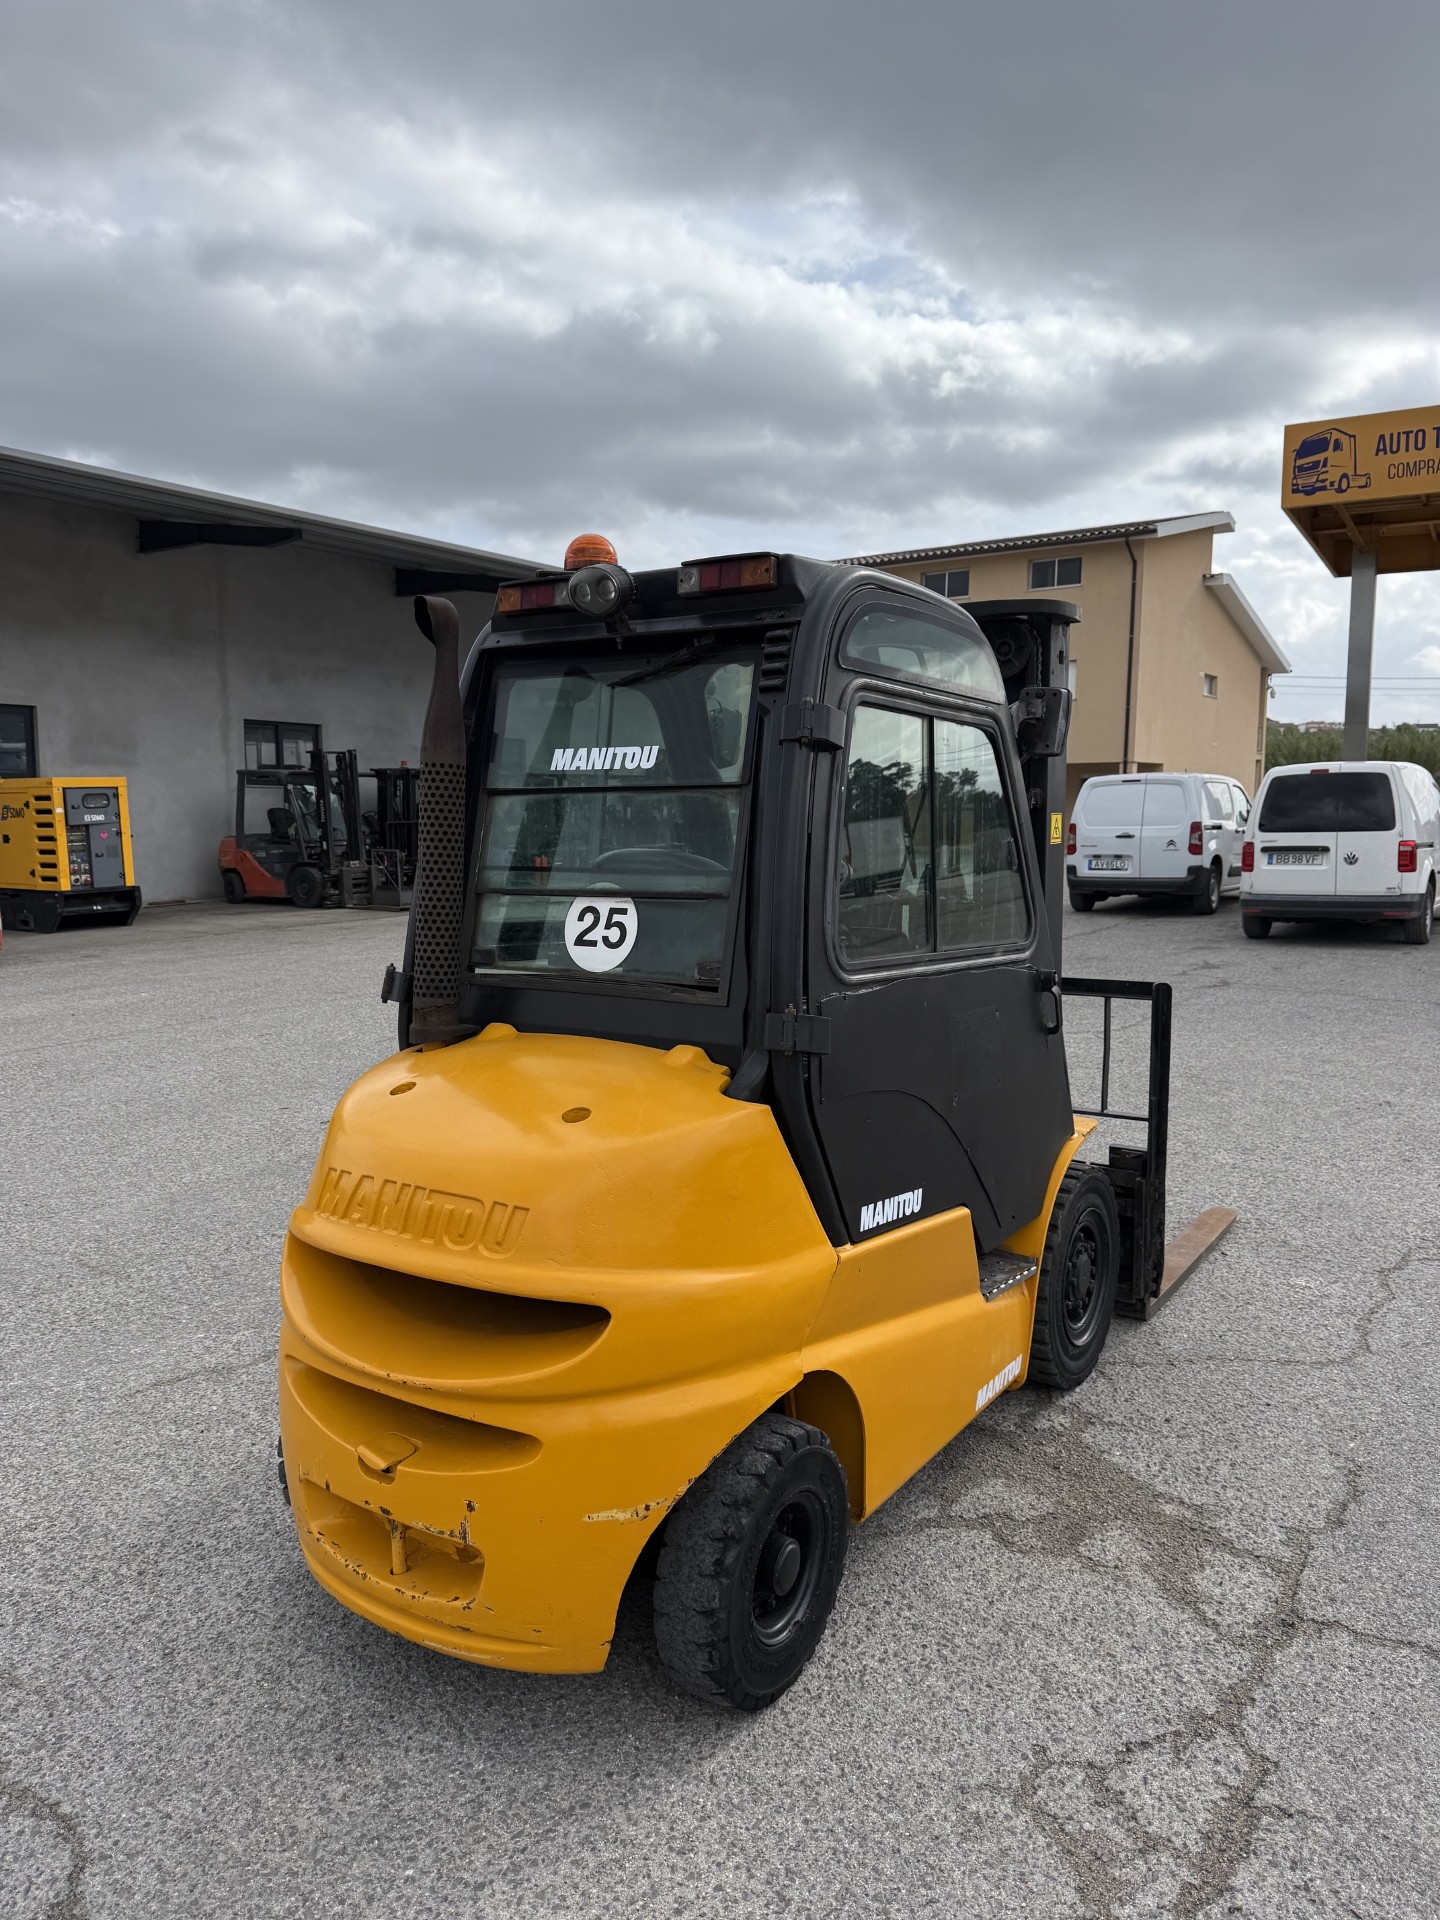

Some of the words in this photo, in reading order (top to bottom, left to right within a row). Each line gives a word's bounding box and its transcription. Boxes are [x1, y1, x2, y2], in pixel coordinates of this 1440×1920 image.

[1375, 429, 1426, 456] AUTO
[551, 746, 659, 770] MANITOU
[1276, 854, 1290, 864] BB
[1305, 854, 1319, 864] VF
[574, 906, 628, 949] 25
[315, 1167, 530, 1258] MANITOU
[860, 1188, 923, 1232] MANITOU
[975, 1354, 1022, 1411] MANITOU
